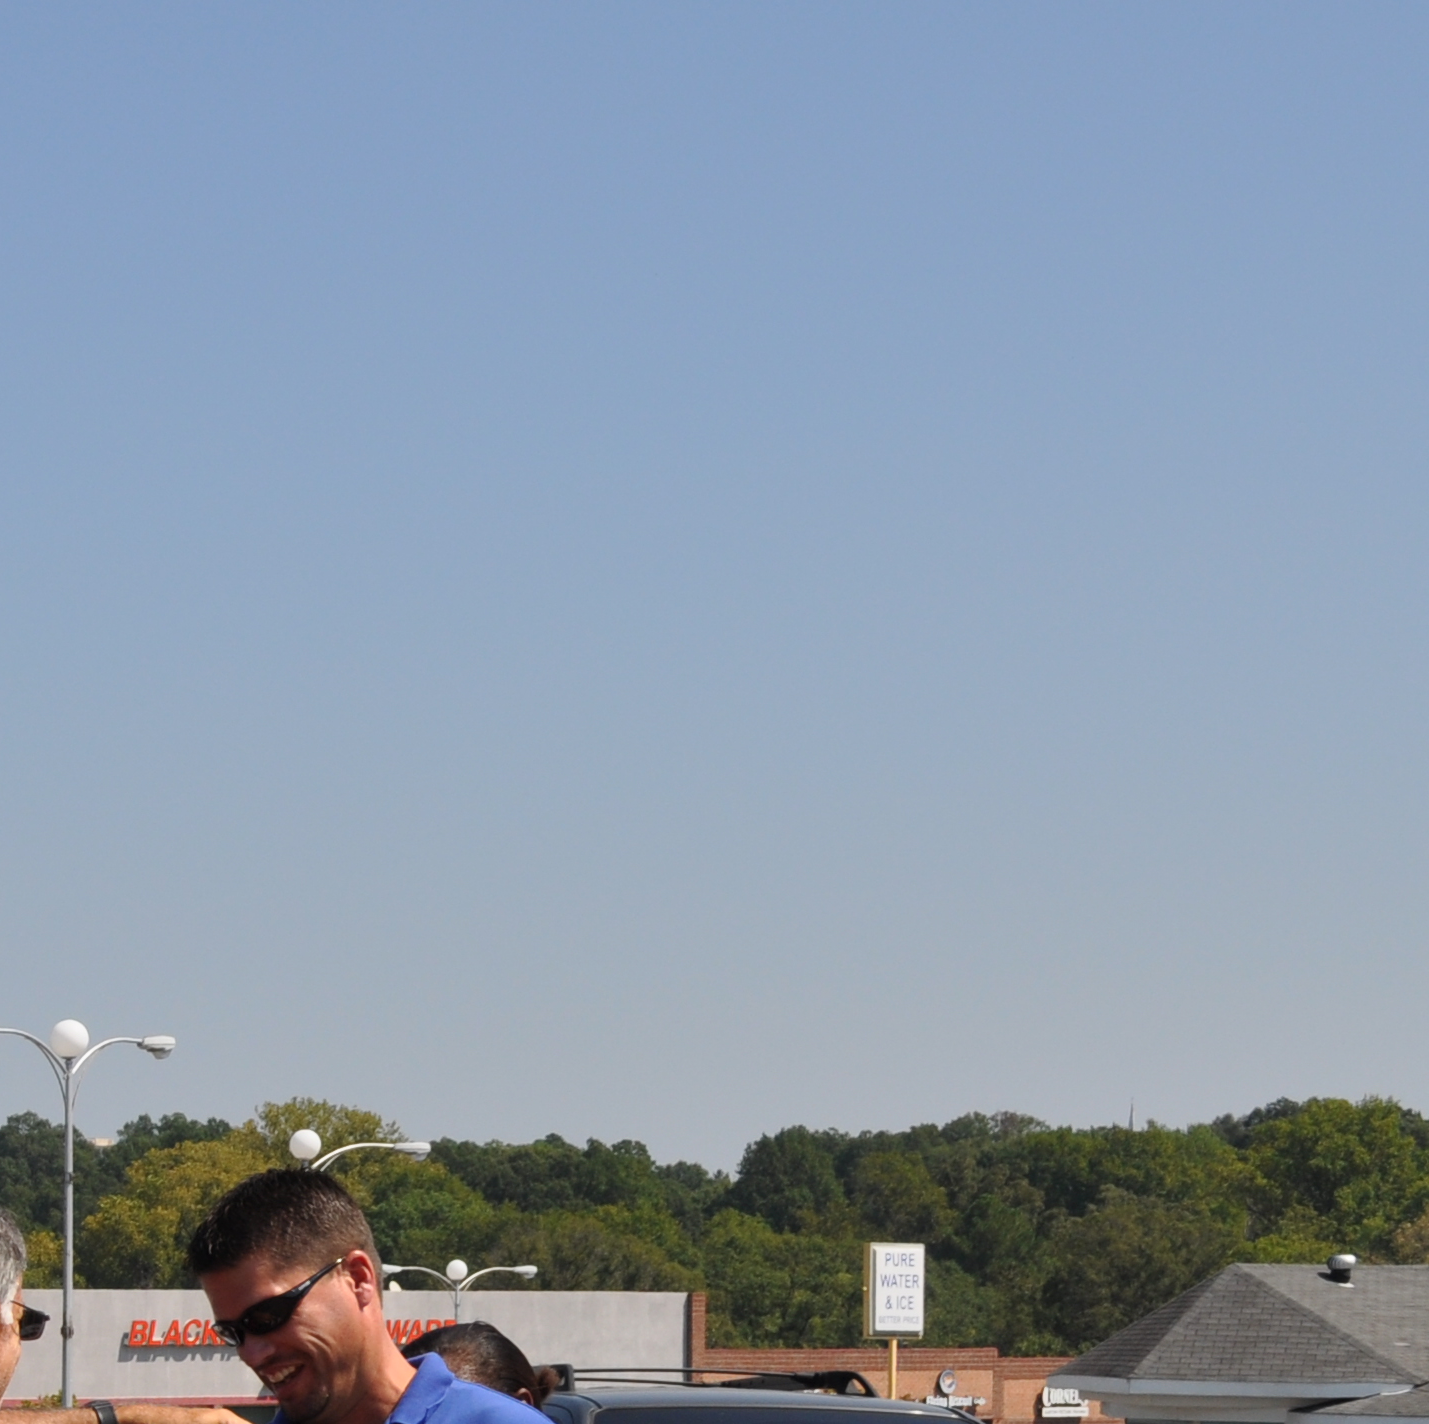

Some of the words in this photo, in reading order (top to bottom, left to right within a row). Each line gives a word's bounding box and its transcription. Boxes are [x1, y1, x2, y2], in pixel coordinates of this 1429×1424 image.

[884, 1252, 916, 1267] PURE
[880, 1273, 920, 1288] WATER
[885, 1295, 893, 1310] &
[896, 1295, 915, 1310] ICE
